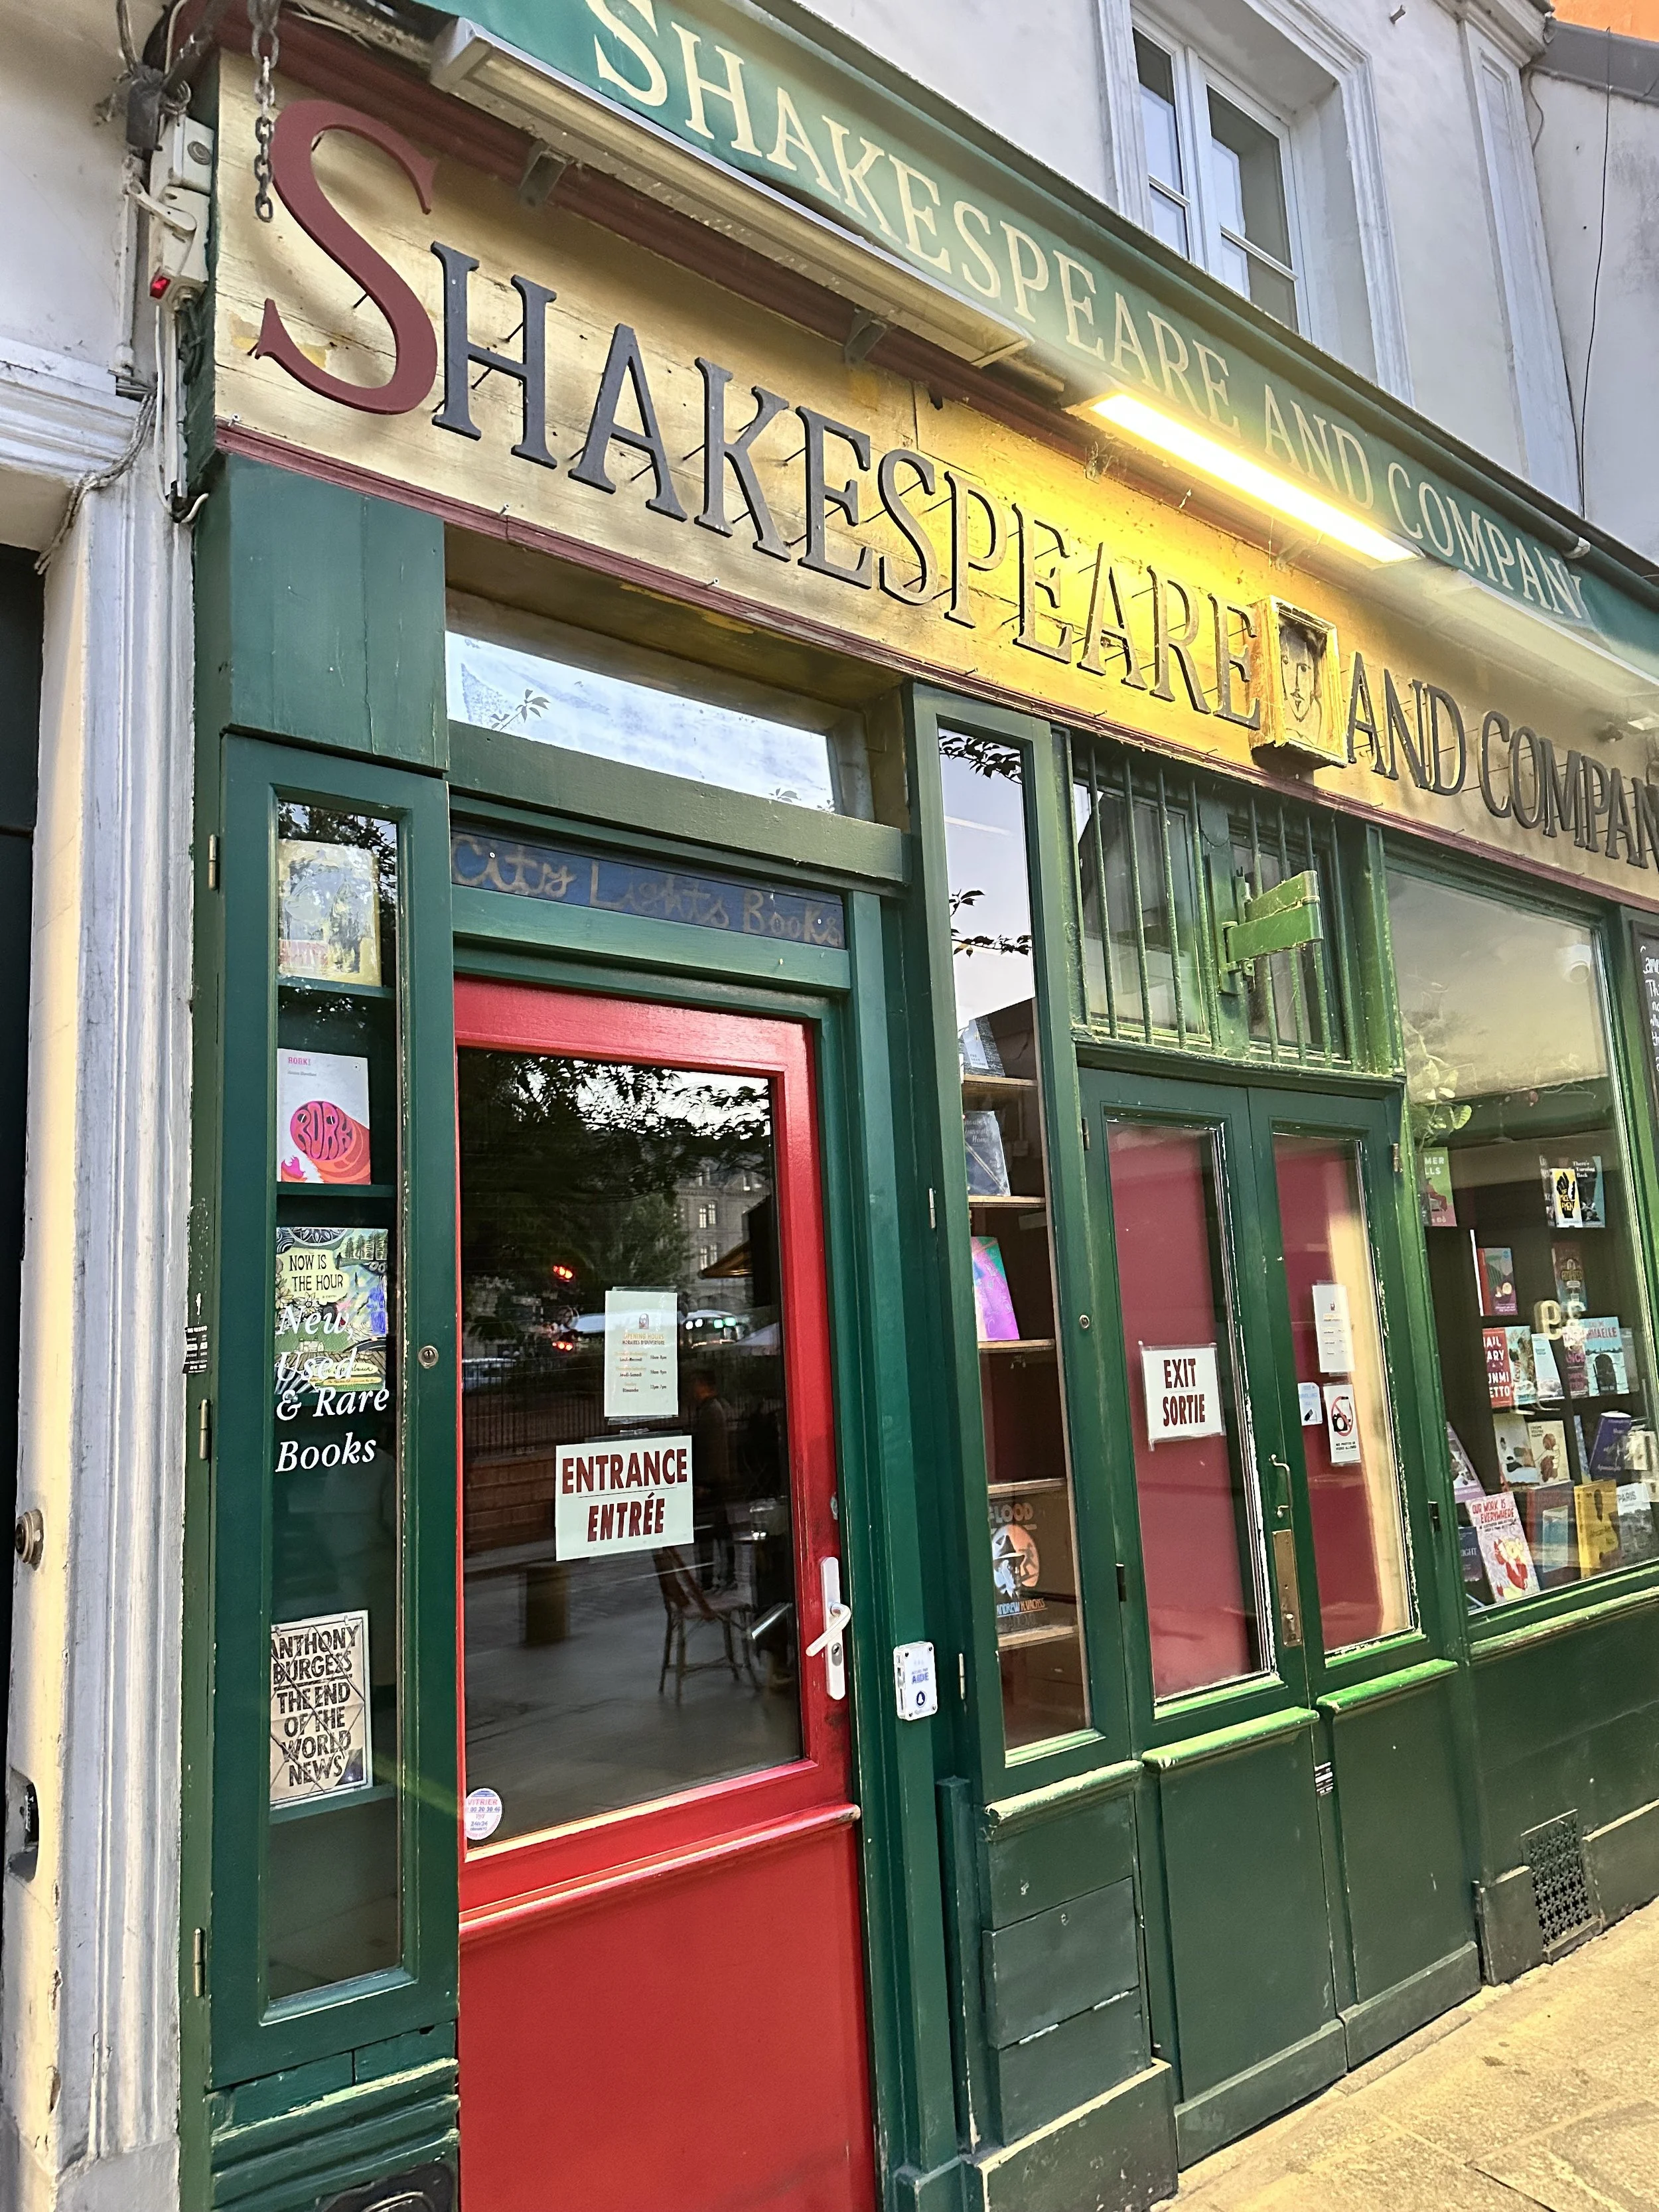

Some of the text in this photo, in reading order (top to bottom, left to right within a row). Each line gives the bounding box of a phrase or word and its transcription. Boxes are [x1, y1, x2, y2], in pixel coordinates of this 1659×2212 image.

[586, 0, 1242, 438] SHAKESPEARE
[1263, 384, 1374, 510] AND
[255, 100, 1260, 731] SHAKESPEARE
[1346, 650, 1467, 796] AND
[452, 834, 843, 947] City Lights Books
[289, 1254, 327, 1272] NOW IS
[292, 1274, 344, 1292] THE HOUR
[276, 1347, 358, 1382] Used
[1163, 1358, 1196, 1389] EXIT
[276, 1385, 390, 1422] & Rare
[1163, 1394, 1206, 1427] SORTIE
[275, 1432, 377, 1473] Books
[561, 1447, 687, 1495] ENTRANCE
[587, 1491, 666, 1542] ENTRÉE
[1472, 1499, 1506, 1514] OUR WORK IS
[1480, 1508, 1514, 1524] EVERYWHERE
[996, 1601, 1020, 1615] ANDREW
[270, 1625, 360, 1660] ANTHONY
[273, 1650, 353, 1685] BURGESS
[277, 1681, 350, 1714] THE END
[284, 1706, 346, 1737] OF THE
[281, 1730, 352, 1763] WORLD
[289, 1755, 343, 1787] NEWS
